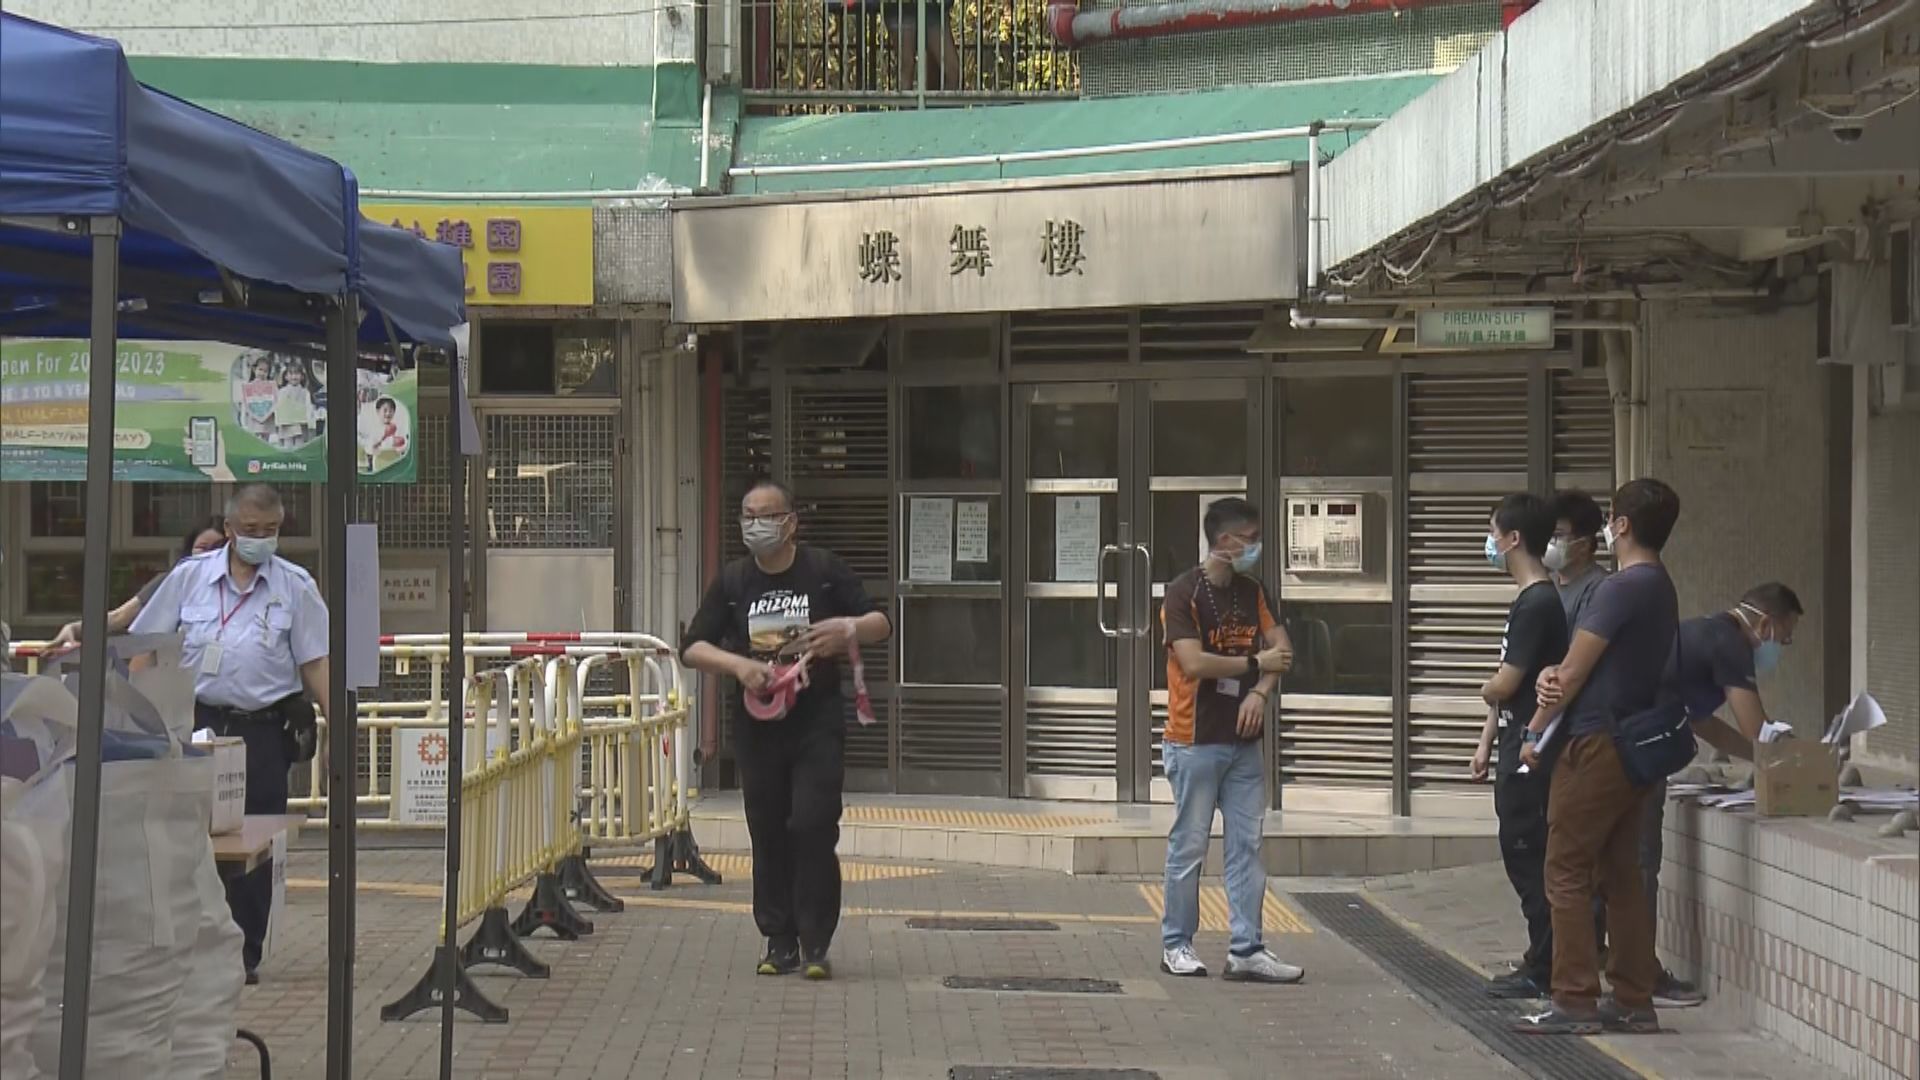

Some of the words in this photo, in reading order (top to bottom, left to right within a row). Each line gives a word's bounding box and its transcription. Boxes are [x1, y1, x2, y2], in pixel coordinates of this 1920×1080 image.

[858, 219, 1087, 284] 蝶舞樓
[1443, 311, 1500, 325] FIREMAN'S
[1503, 311, 1526, 324] LIFT
[36, 351, 61, 375] For
[748, 594, 809, 616] ARIZONA
